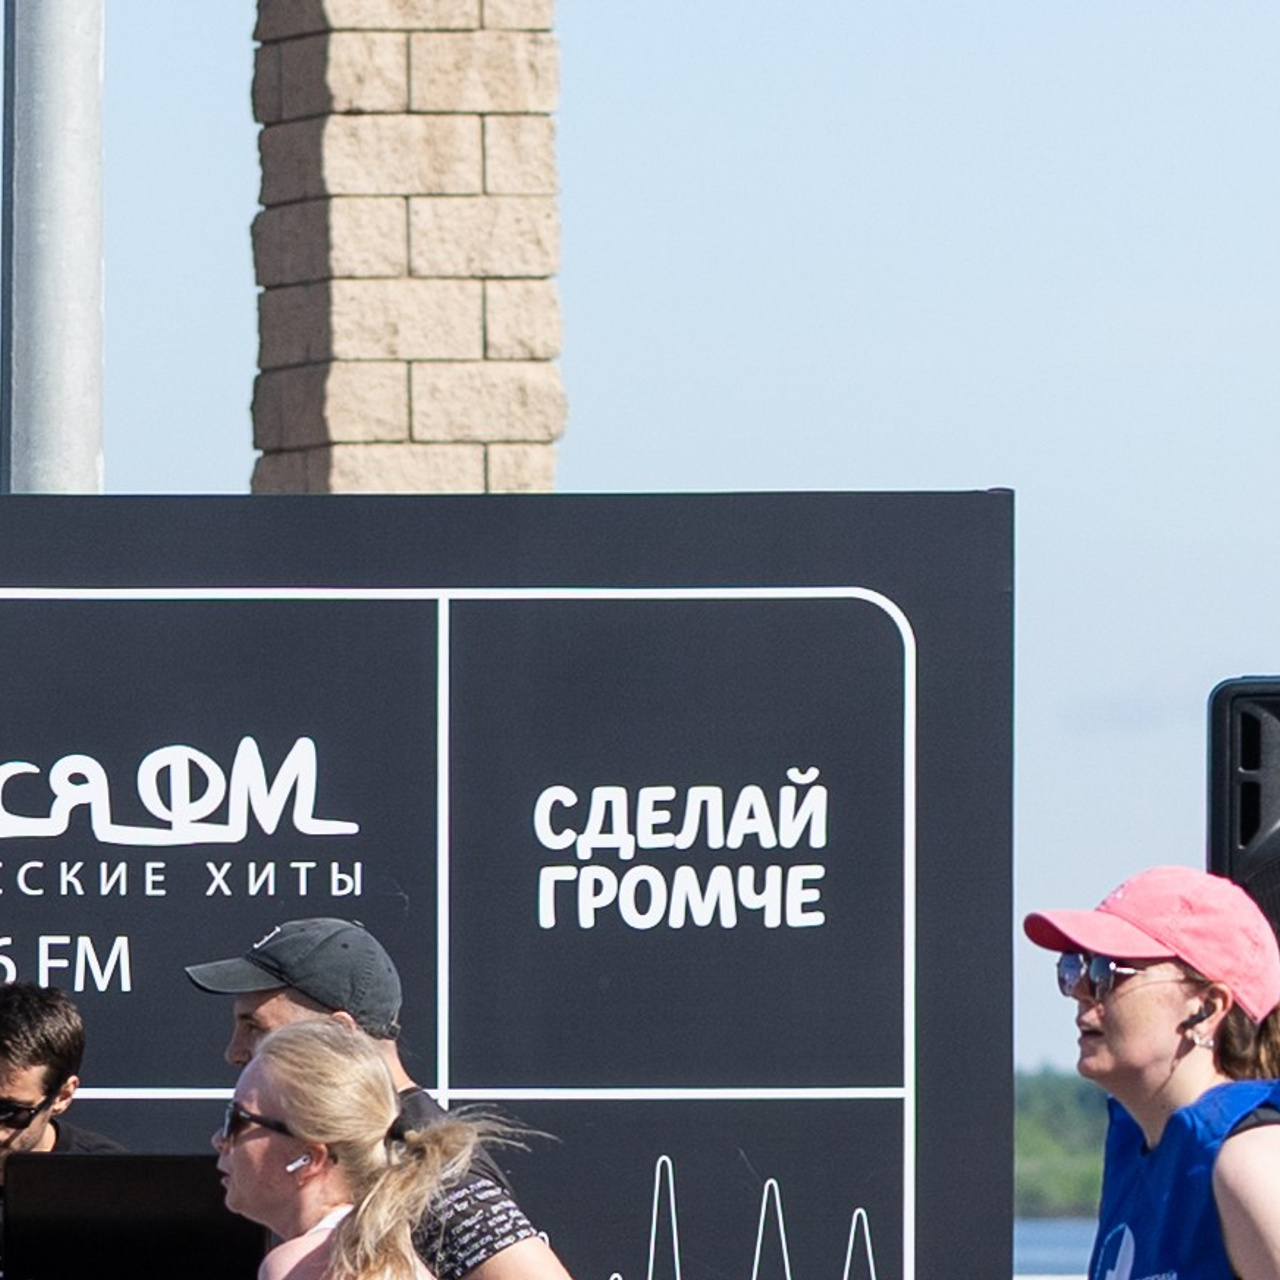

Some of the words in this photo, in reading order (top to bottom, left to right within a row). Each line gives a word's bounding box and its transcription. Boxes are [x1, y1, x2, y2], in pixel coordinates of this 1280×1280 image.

[136, 735, 360, 847] ФМ
[534, 766, 827, 859] СДЕЛАЙ
[206, 861, 363, 897] ХИТЫ
[538, 864, 826, 931] ГРОМЧЕ
[38, 935, 132, 993] FM
